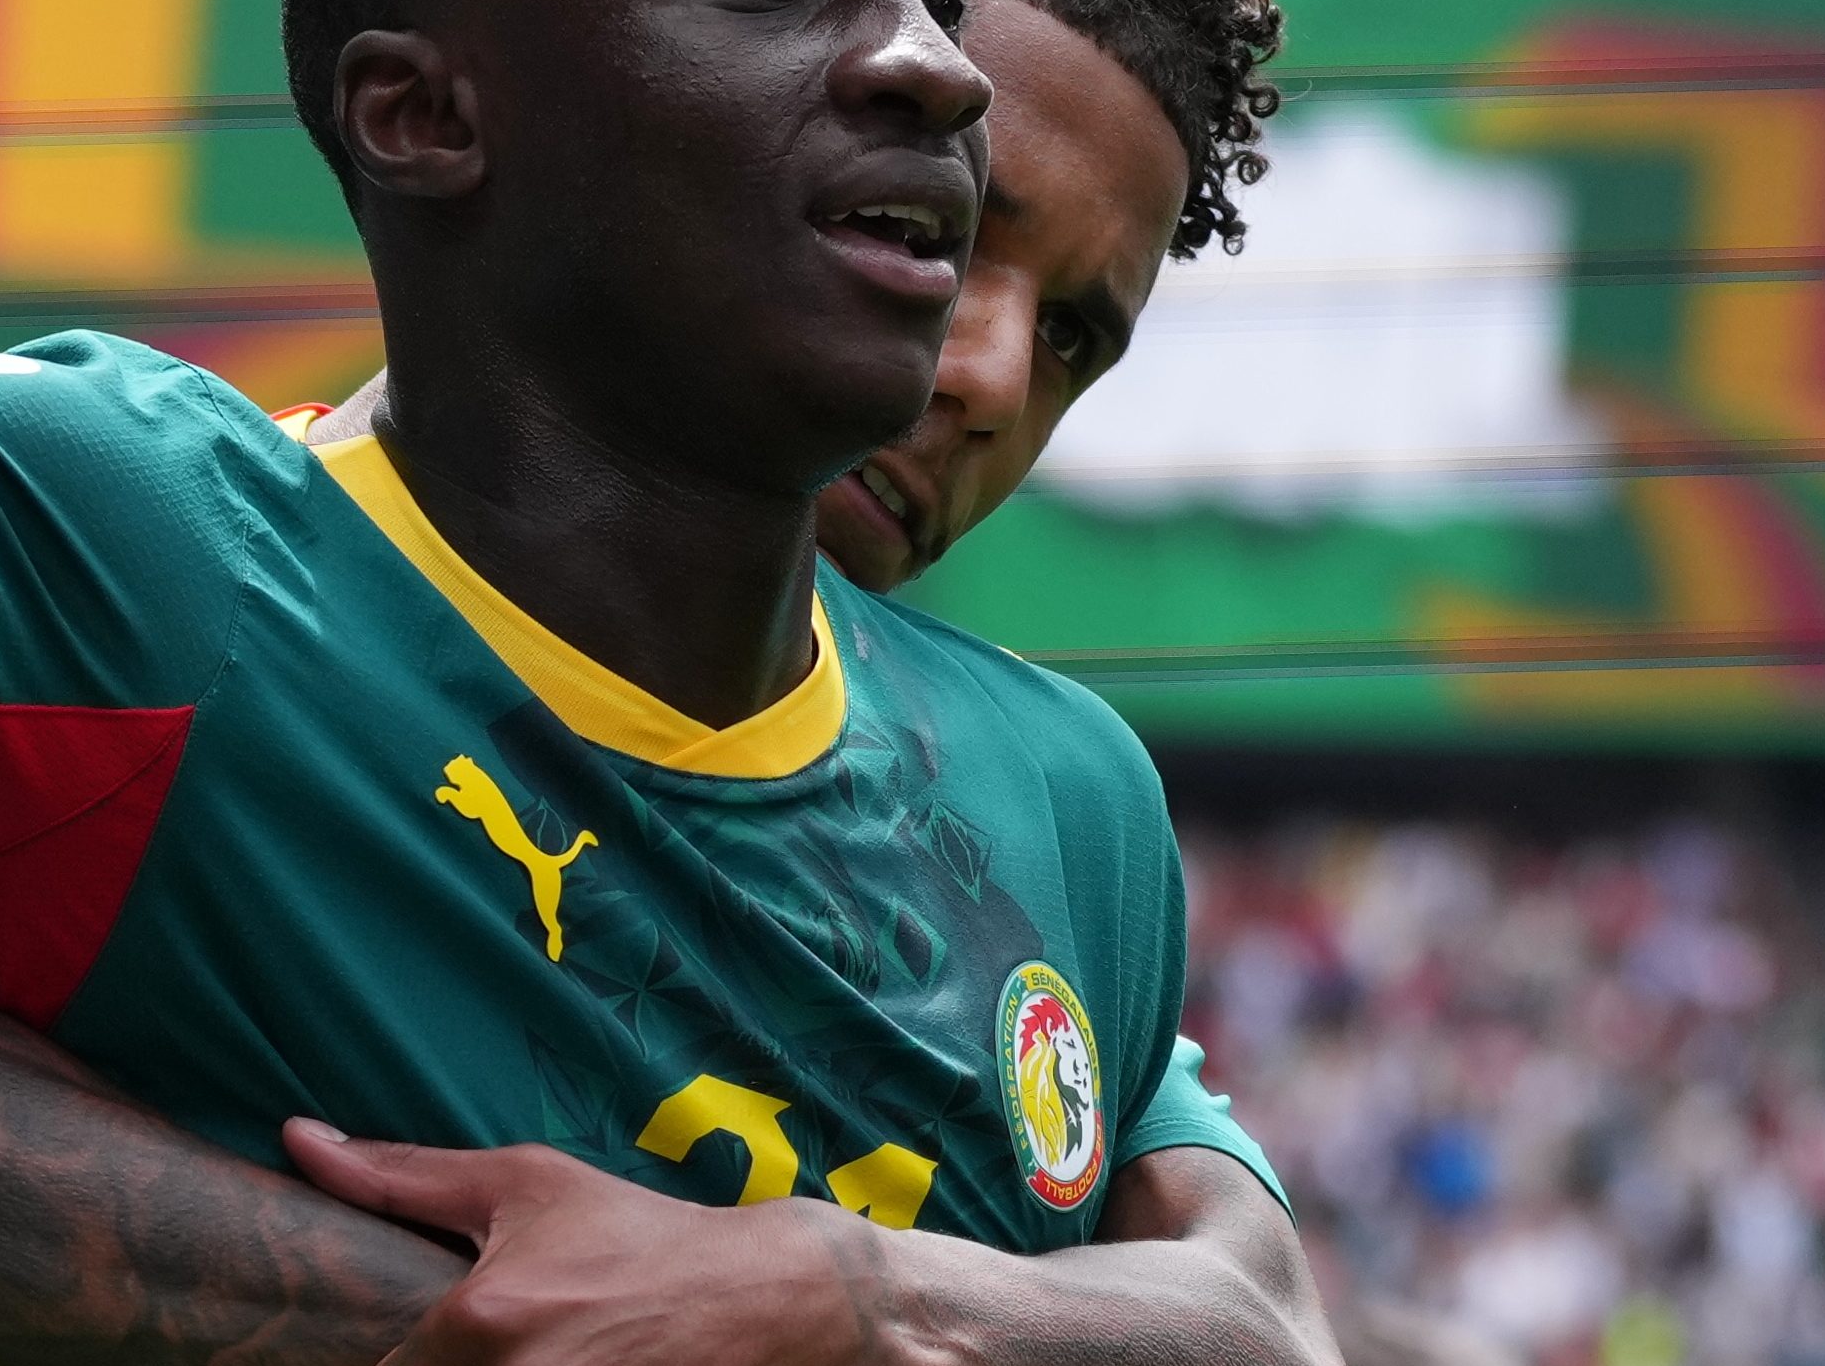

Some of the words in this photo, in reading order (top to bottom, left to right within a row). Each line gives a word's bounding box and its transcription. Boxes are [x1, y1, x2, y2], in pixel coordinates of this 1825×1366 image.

[1002, 994, 1028, 1151] FÉDÉRATION
[1031, 967, 1099, 1081] SÉNÉGALAISE
[1043, 1158, 1098, 1201] FOOTBALL
